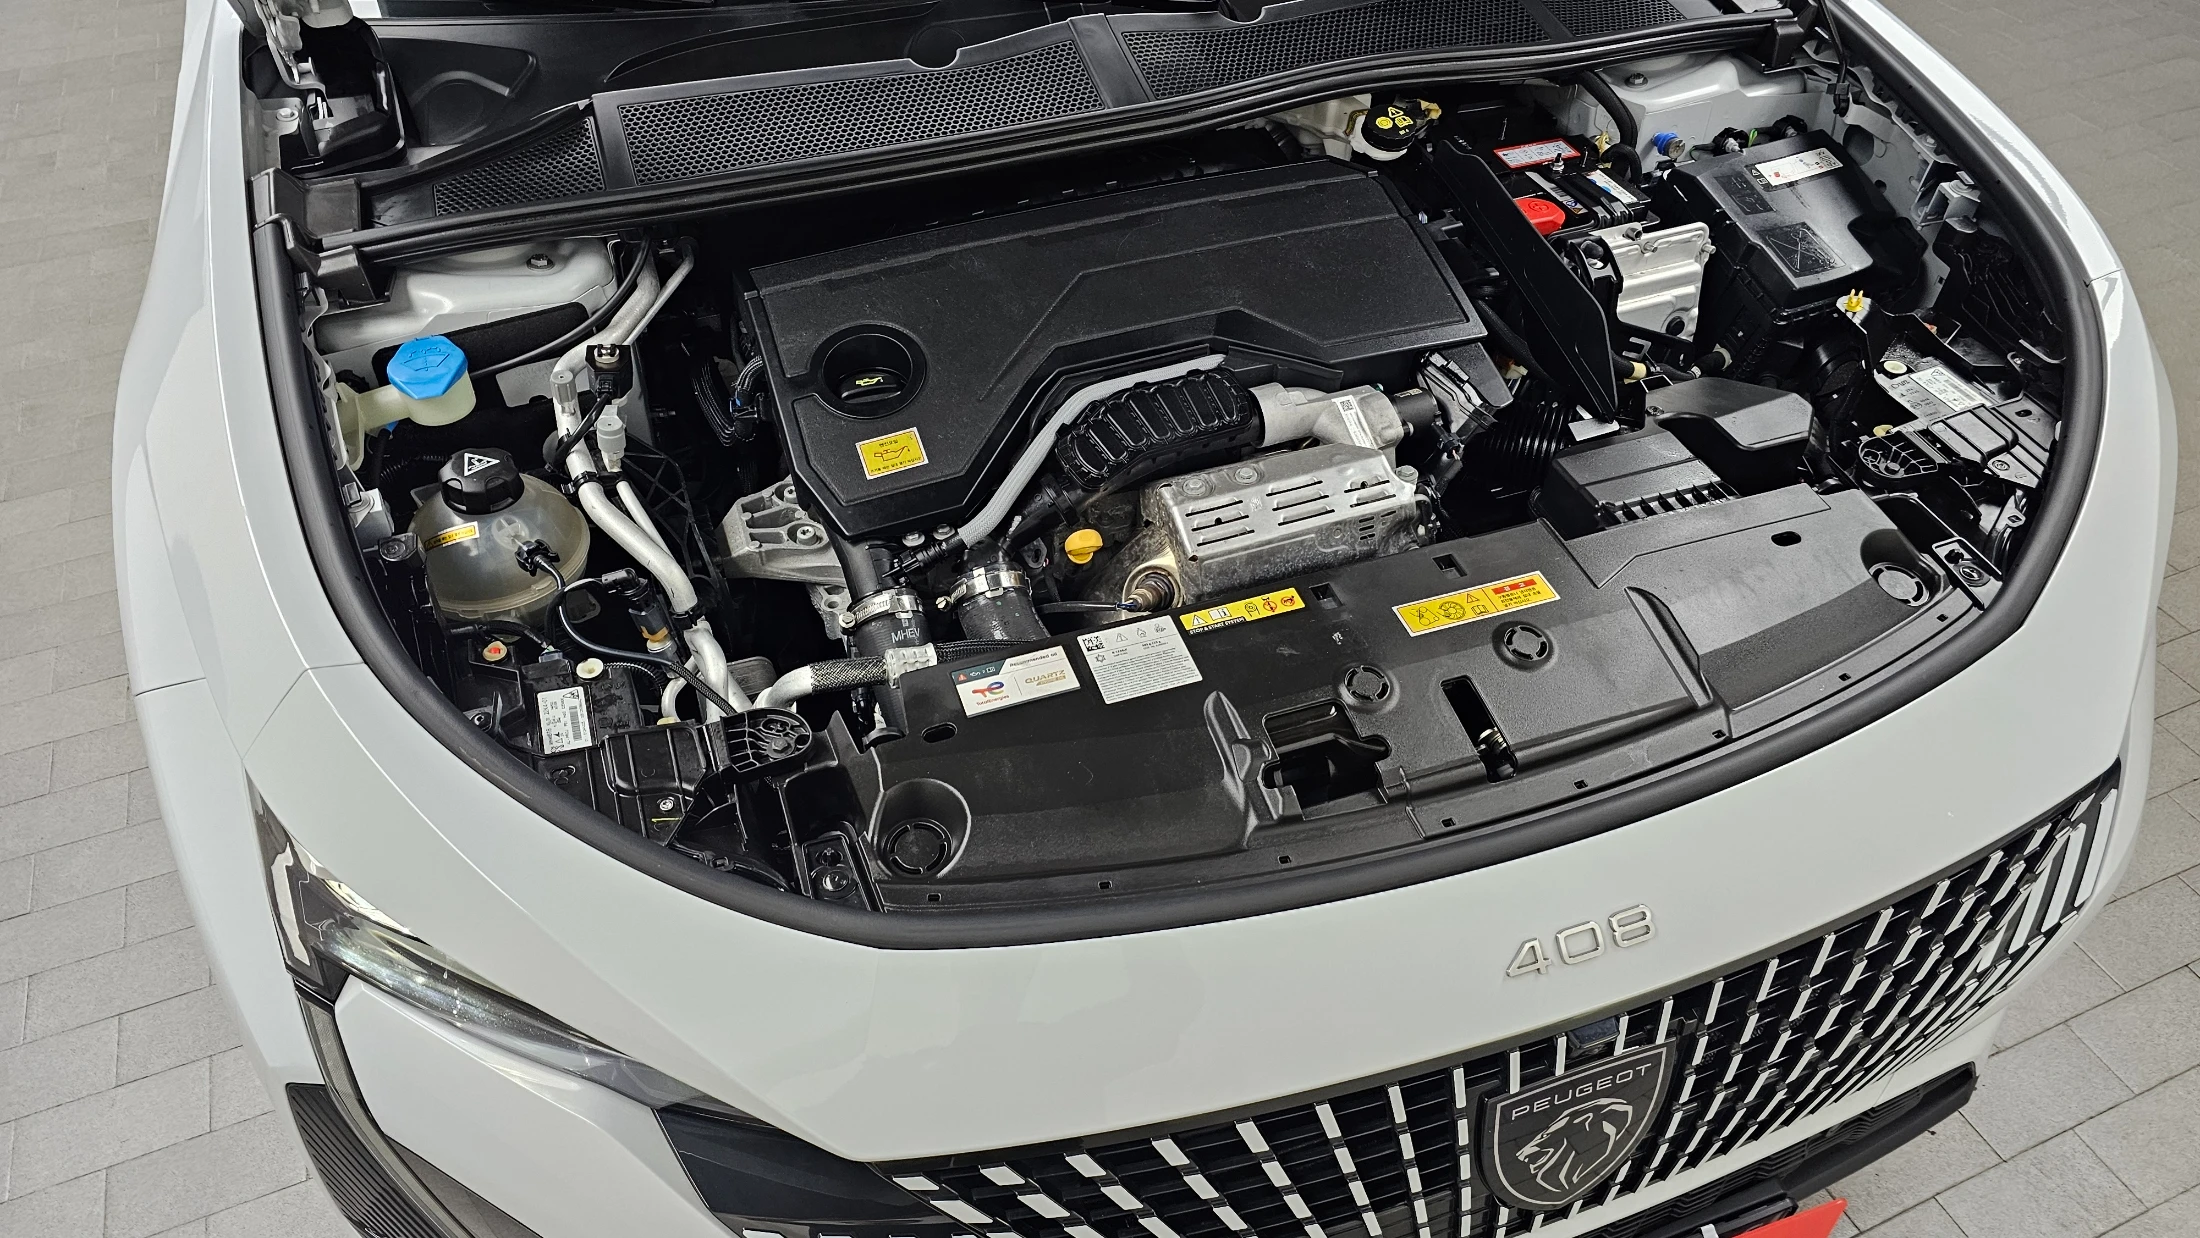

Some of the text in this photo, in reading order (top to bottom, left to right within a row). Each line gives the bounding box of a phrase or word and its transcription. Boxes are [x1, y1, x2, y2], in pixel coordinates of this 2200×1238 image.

[1189, 627, 1204, 635] STOP
[1208, 622, 1225, 631] START
[1225, 617, 1245, 626] SYSTEM
[891, 628, 919, 643] MHEV
[1009, 652, 1050, 667] Recommended
[1025, 669, 1066, 684] QUARTZ
[1505, 903, 1655, 977] 408
[1511, 1063, 1652, 1121] PEUGEOT
